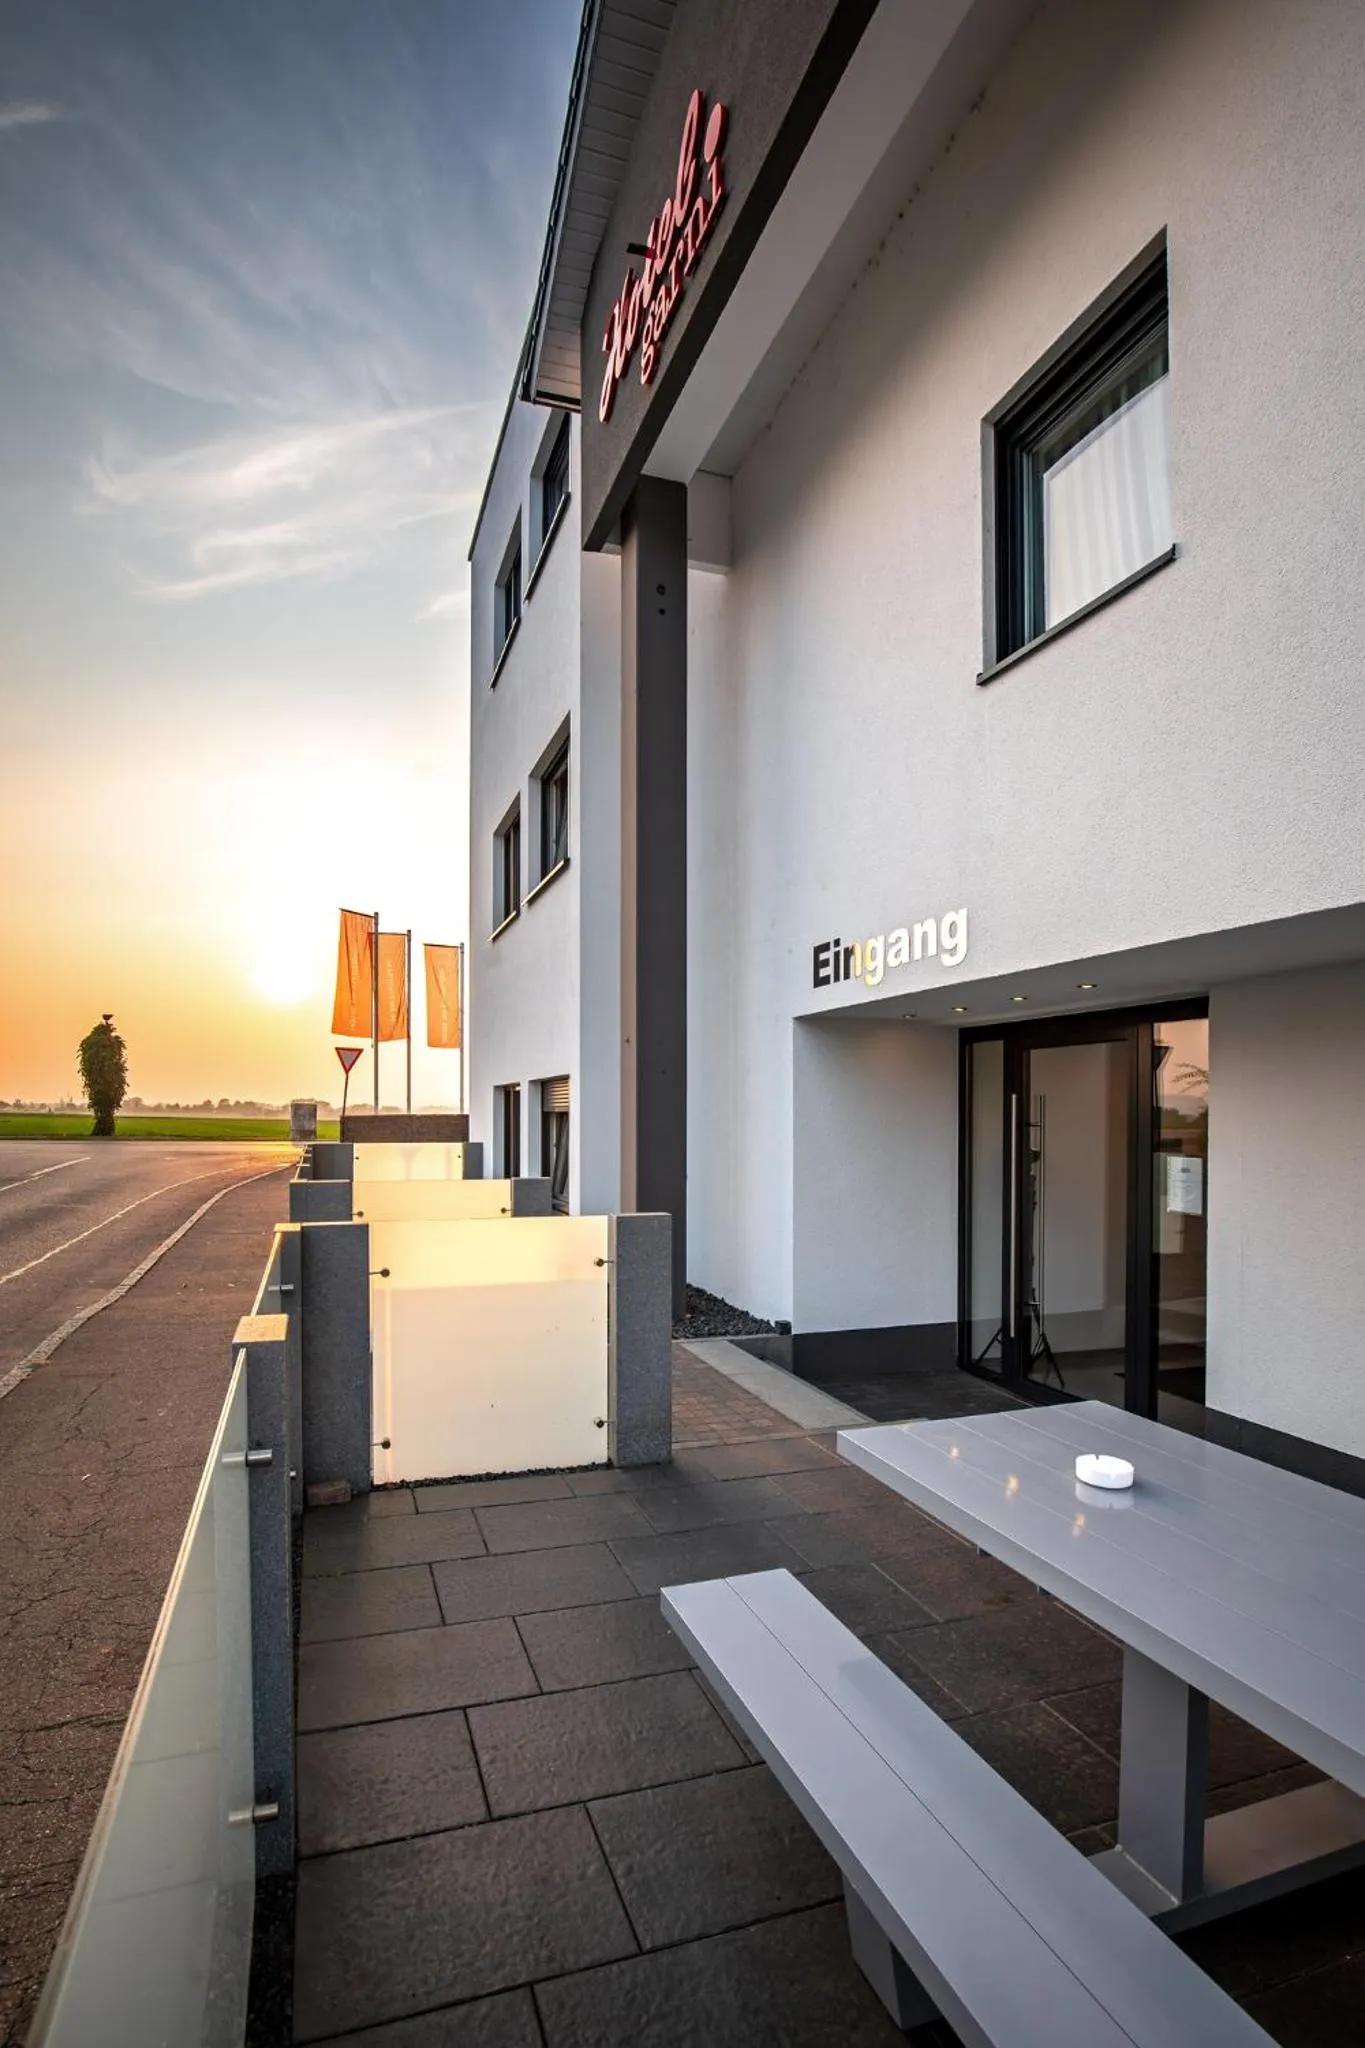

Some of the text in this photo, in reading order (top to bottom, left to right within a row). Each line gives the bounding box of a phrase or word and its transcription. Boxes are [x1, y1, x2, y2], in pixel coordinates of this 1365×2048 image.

[600, 88, 701, 424] Hotel
[641, 102, 724, 386] garni
[812, 907, 969, 989] Eingang
